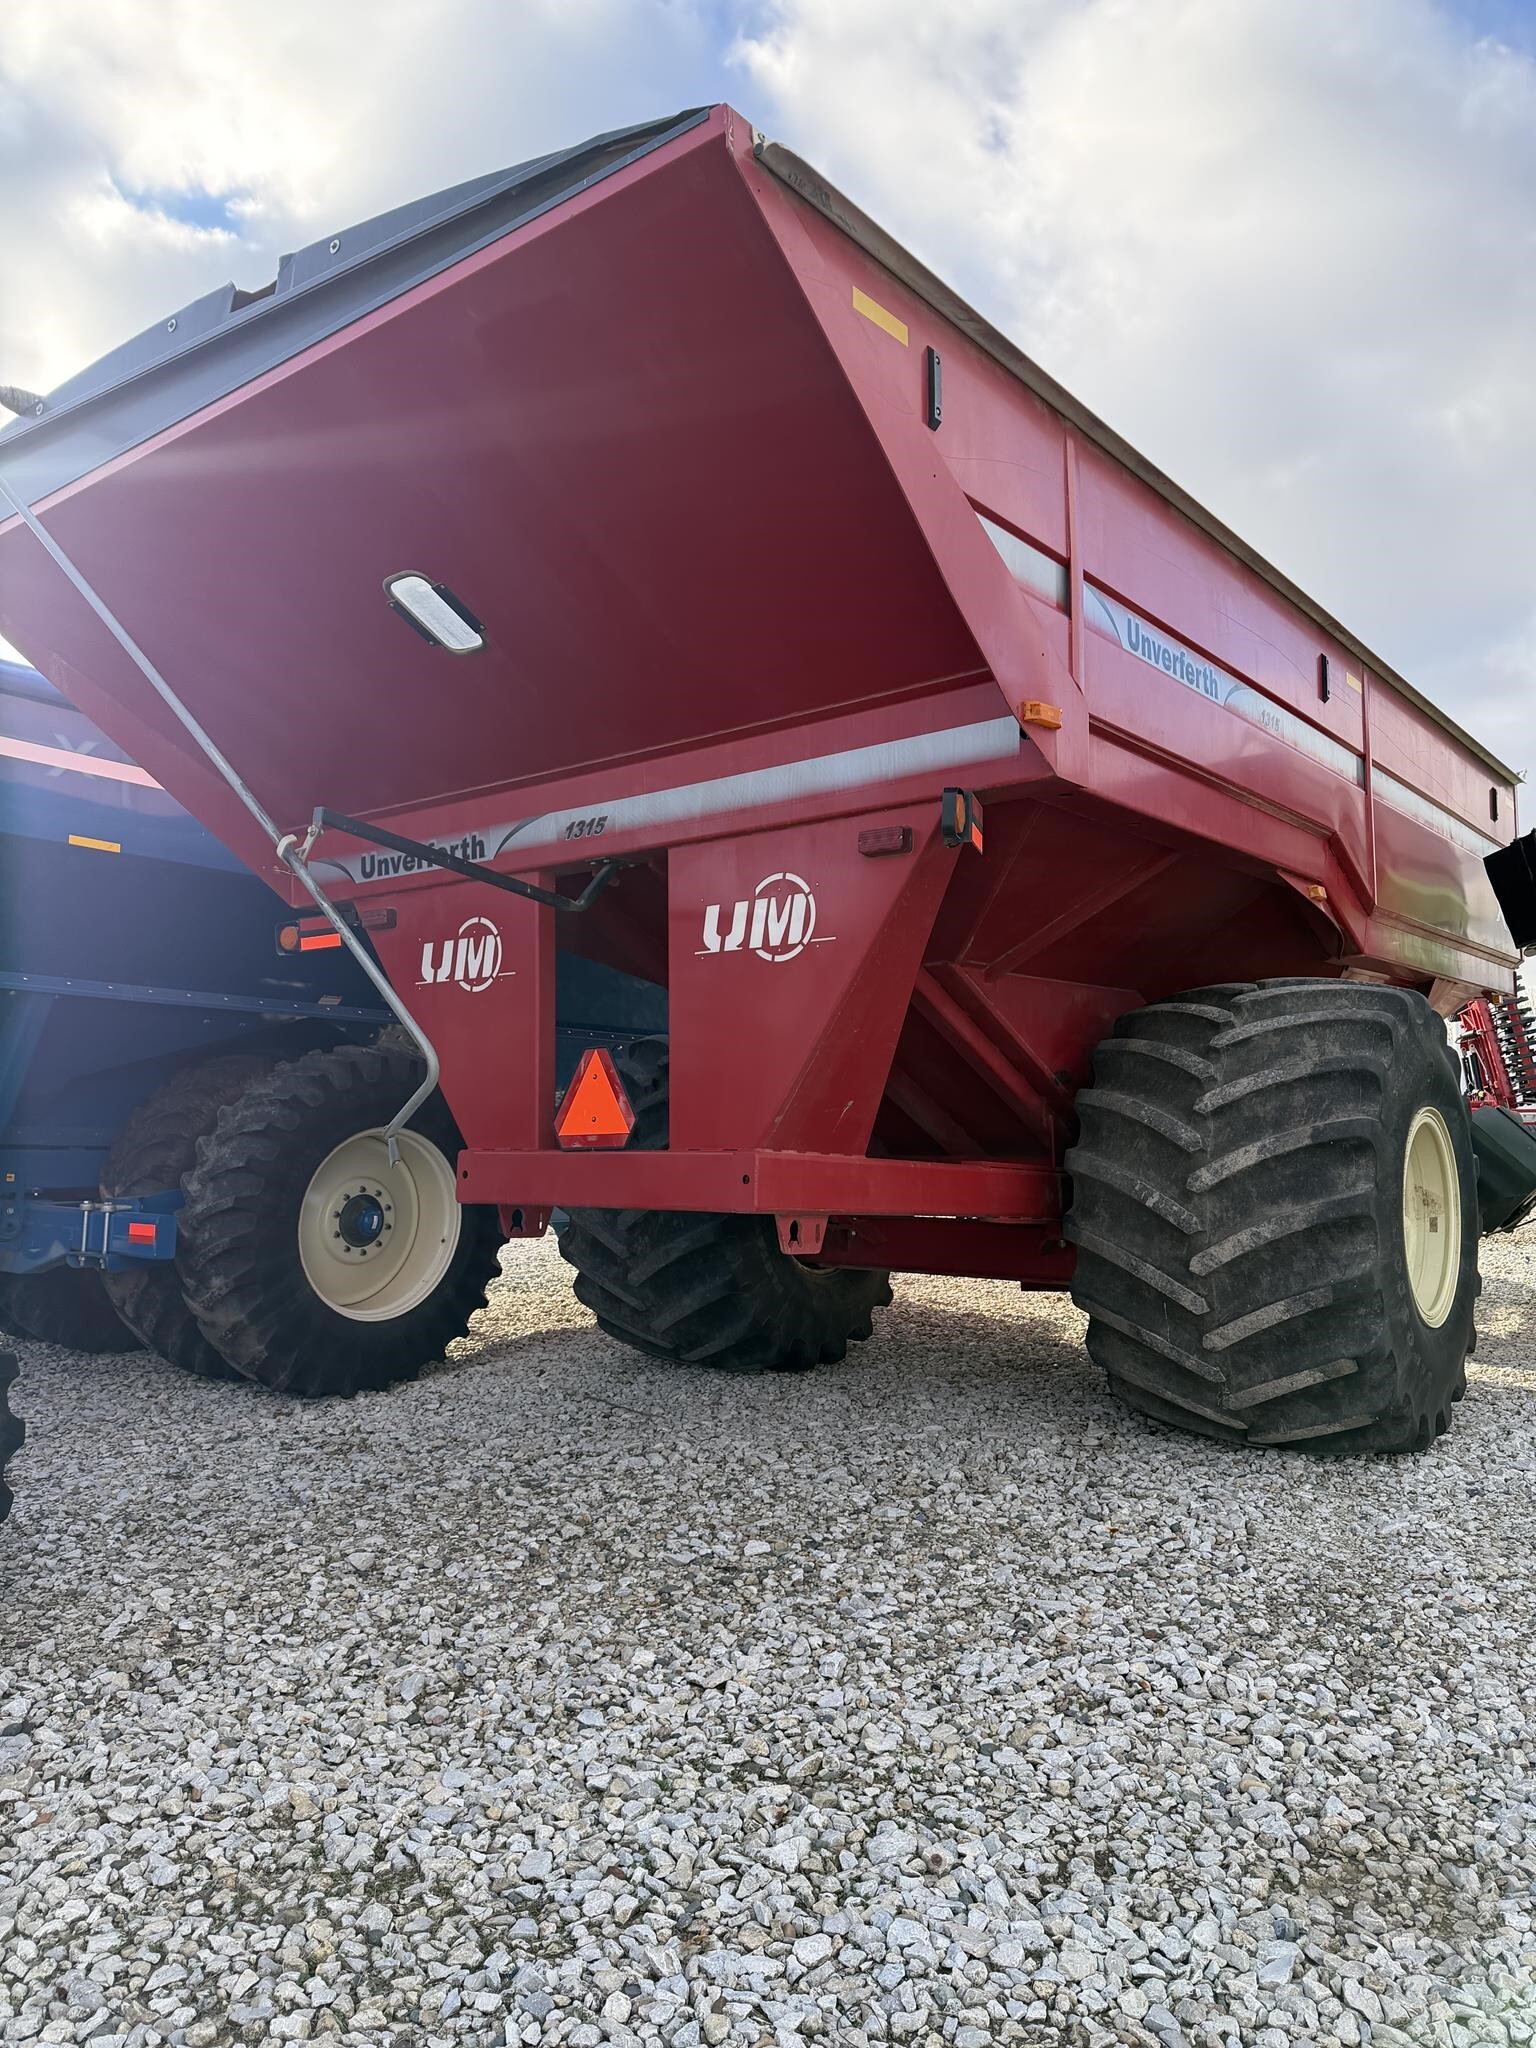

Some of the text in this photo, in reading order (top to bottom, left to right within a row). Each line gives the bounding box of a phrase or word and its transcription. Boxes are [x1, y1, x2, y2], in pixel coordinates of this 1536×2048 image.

[1126, 616, 1220, 700] Unverferth
[564, 815, 609, 841] 1315
[695, 891, 809, 954] UM
[415, 933, 499, 985] UM
